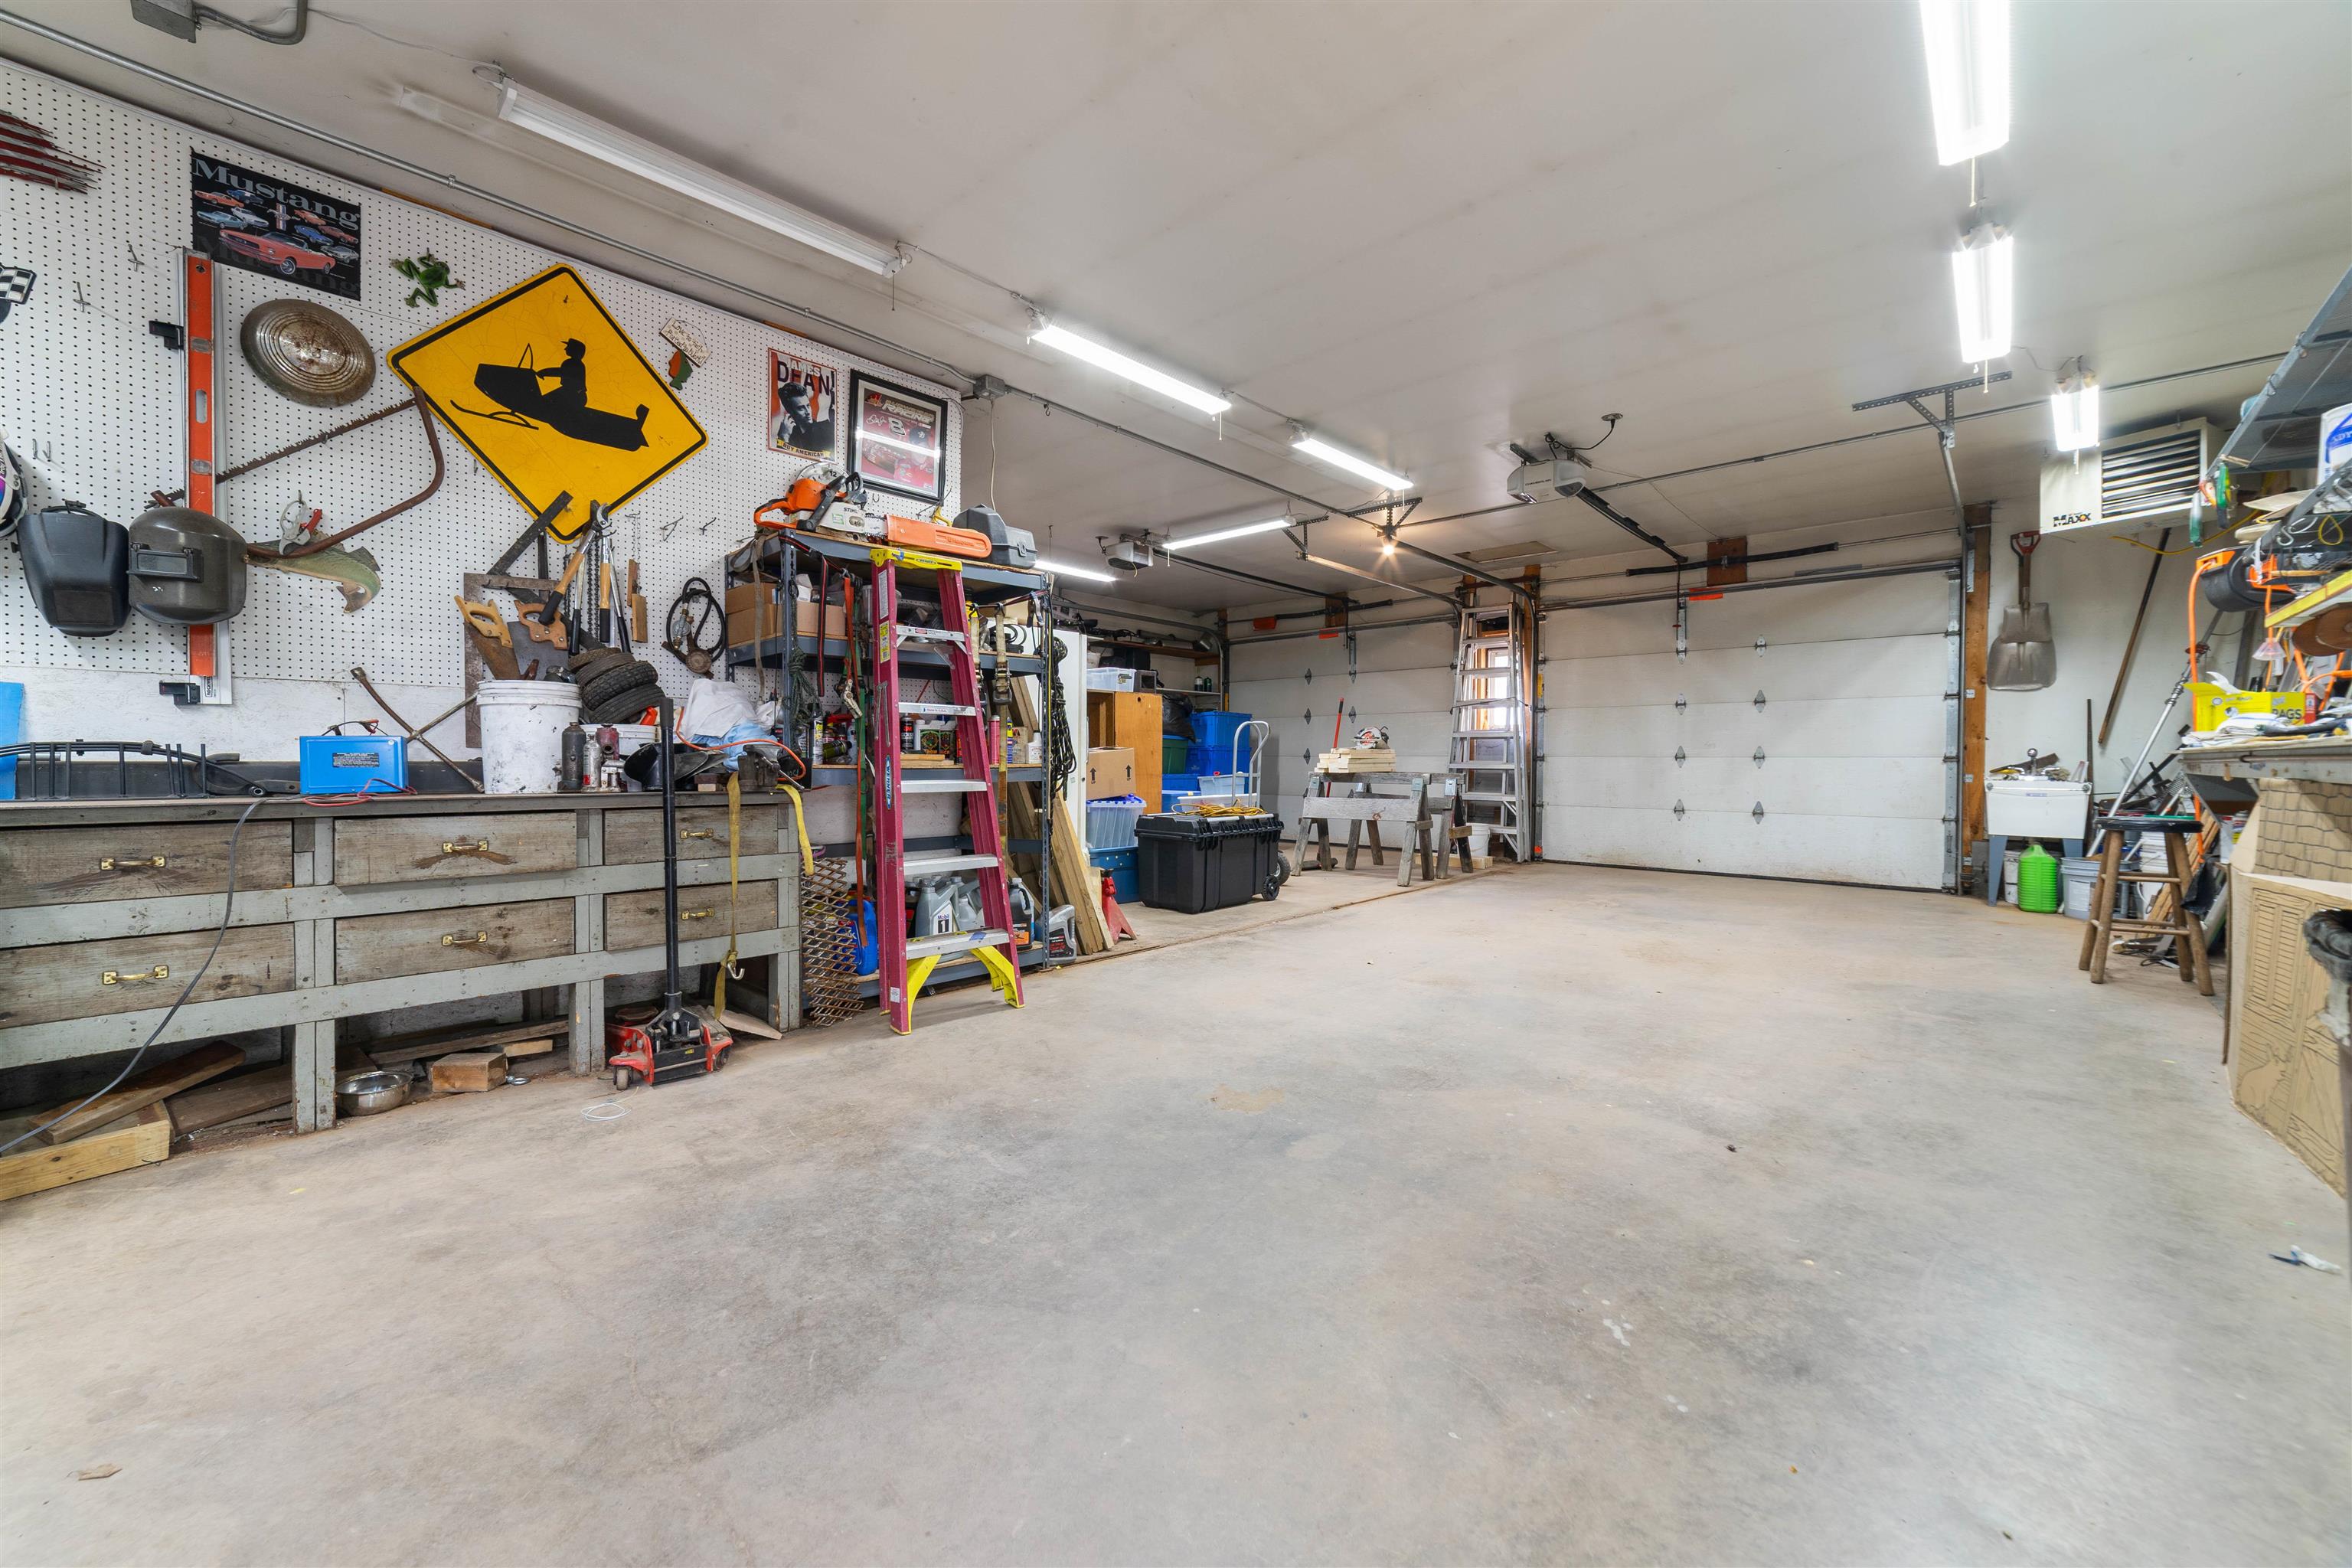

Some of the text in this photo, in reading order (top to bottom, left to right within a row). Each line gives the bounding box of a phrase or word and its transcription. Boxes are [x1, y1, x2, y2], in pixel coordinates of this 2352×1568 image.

[192, 158, 361, 230] Mustang
[778, 360, 830, 397] DEAN
[882, 403, 934, 424] RACING
[782, 443, 824, 458] BUY AMERICAN
